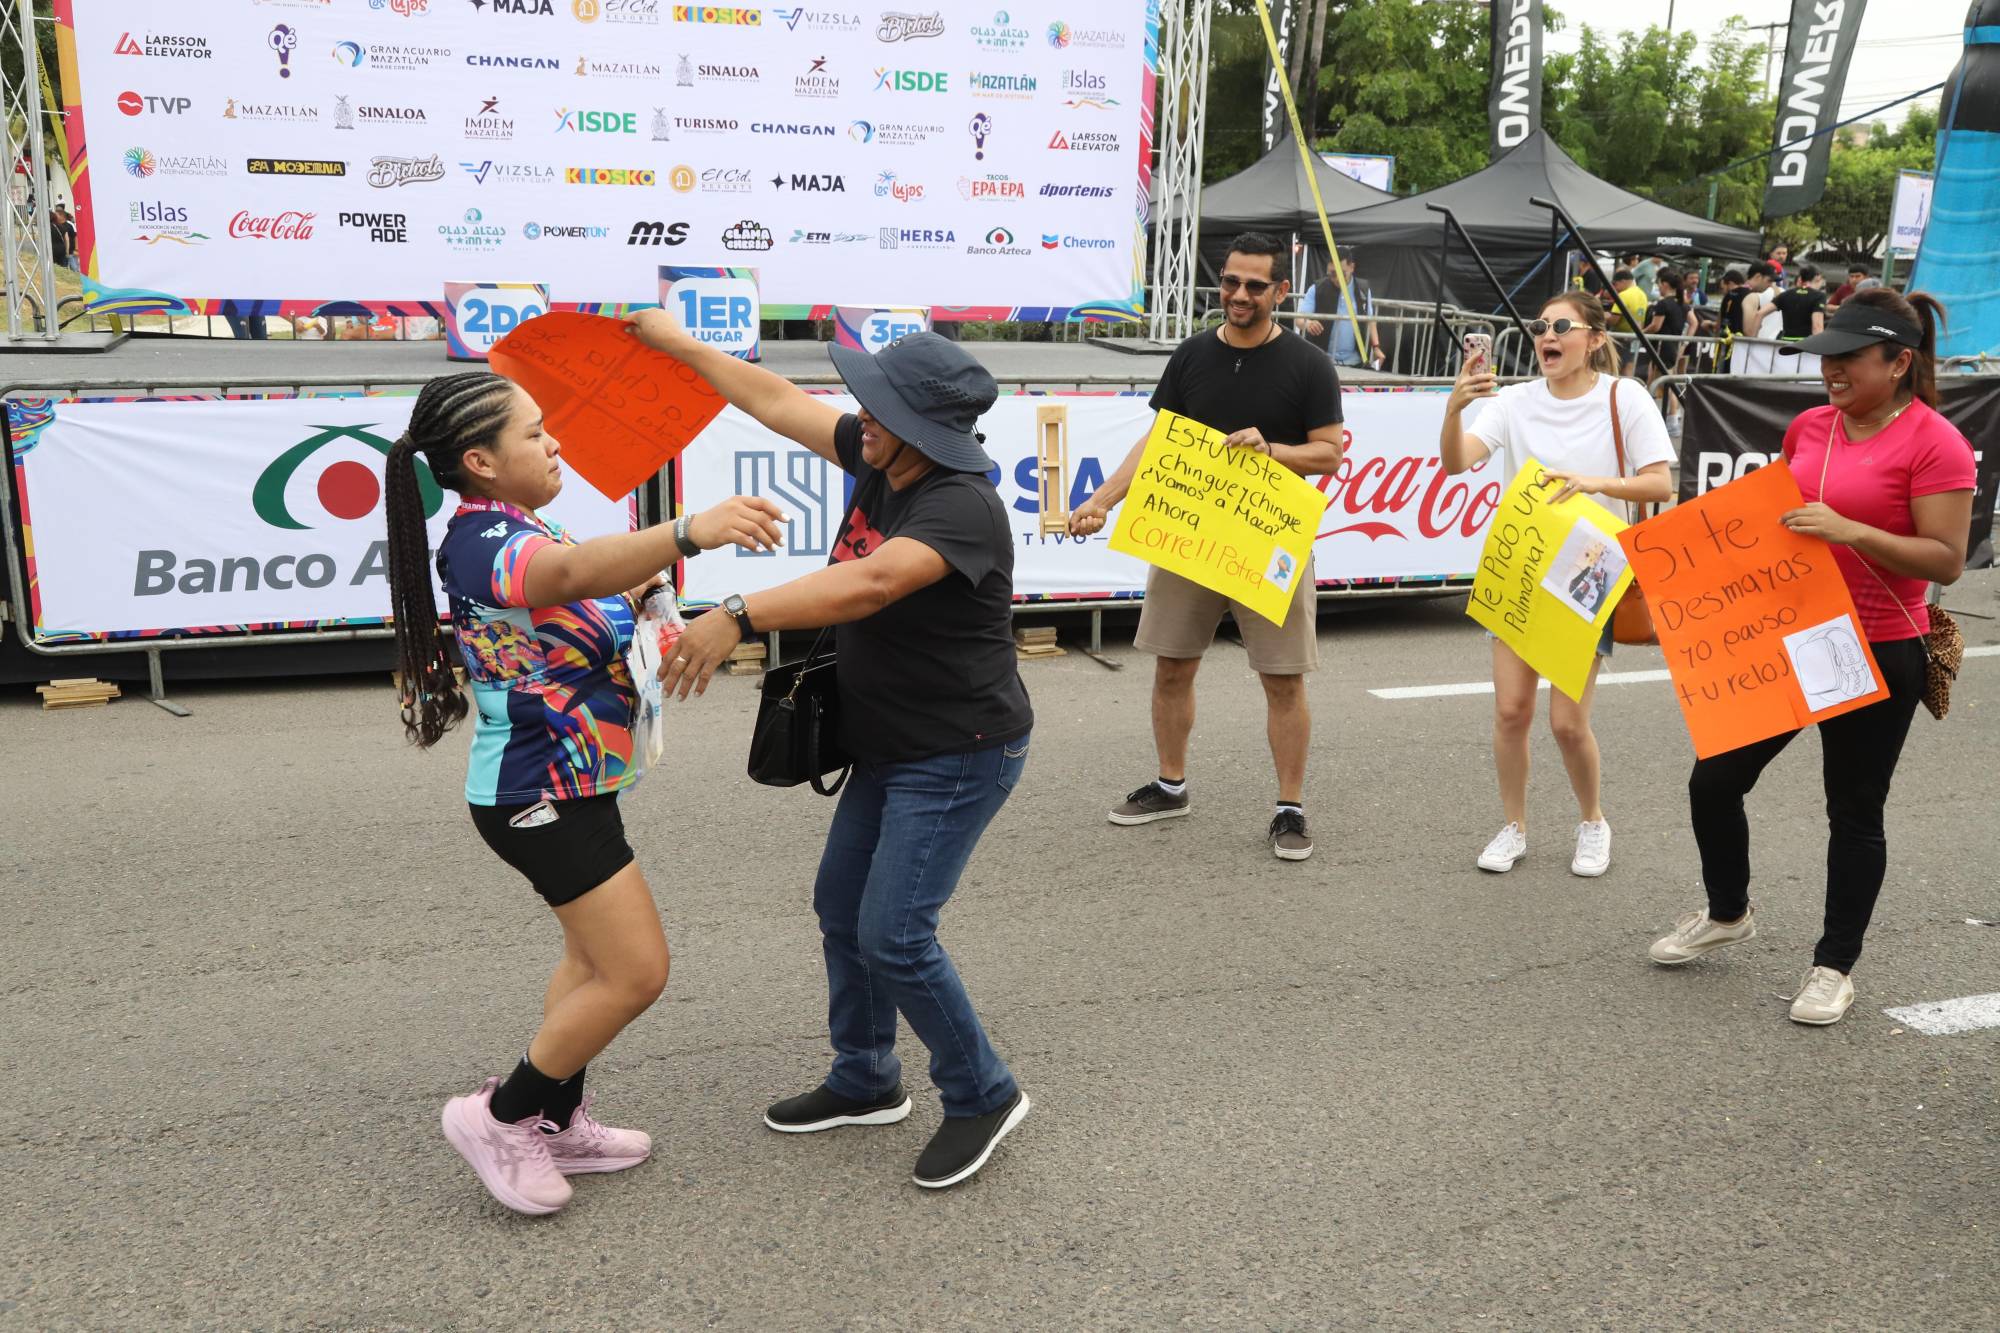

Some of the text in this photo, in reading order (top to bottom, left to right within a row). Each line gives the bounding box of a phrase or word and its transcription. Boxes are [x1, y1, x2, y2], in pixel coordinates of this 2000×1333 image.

[494, 0, 554, 15] MAJA
[673, 6, 761, 26] KIOSKO
[806, 13, 861, 25] VIZSLA
[971, 27, 1029, 39] OLAS ALTAS
[146, 35, 207, 47] LARSSON
[146, 47, 212, 59] ELEVATOR
[371, 45, 451, 57] GRAN ACUARIO
[466, 55, 559, 69] CHANGAN
[698, 65, 760, 78] SINALOA
[795, 76, 839, 88] IMDEM
[895, 70, 948, 92] ISDE
[1070, 70, 1106, 89] Islas
[144, 96, 192, 115] TVP
[359, 106, 426, 120] SINALOA
[465, 117, 514, 130] IMDEM
[578, 111, 637, 134] ISDE
[674, 117, 739, 130] TURISMO
[751, 123, 835, 136] CHANGAN
[905, 125, 945, 133] ACUARIO
[1072, 133, 1117, 142] LARSSON
[1071, 142, 1120, 152] ELEVATOR
[274, 161, 343, 175] MODERNA
[494, 165, 555, 177] VIZSLA
[565, 168, 655, 185] KIOSKO
[792, 174, 845, 192] MAJA
[874, 181, 923, 202] Los Lujos
[972, 181, 1025, 198] EPA EPA
[1039, 183, 1113, 198] dportenis
[130, 201, 139, 223] TRES
[140, 201, 187, 222] Islas
[339, 213, 406, 227] POWER
[371, 229, 407, 242] ADE
[438, 225, 506, 236] OLAS ALTAS
[806, 232, 831, 241] ETN
[900, 229, 955, 243] HERSA
[1063, 235, 1115, 248] Chevron
[967, 246, 1031, 256] Banco Azteca
[678, 289, 752, 329] 1ER
[692, 331, 743, 342] LUGAR
[1166, 415, 1283, 491] Estuviste
[1143, 493, 1201, 531] Ahora
[1483, 523, 1521, 581] Pido
[1634, 509, 1759, 583] Si te
[134, 549, 337, 597] Banco
[1659, 552, 1813, 631] Desmayas
[1471, 588, 1503, 613] Te
[1680, 649, 1791, 707] tu reloj
